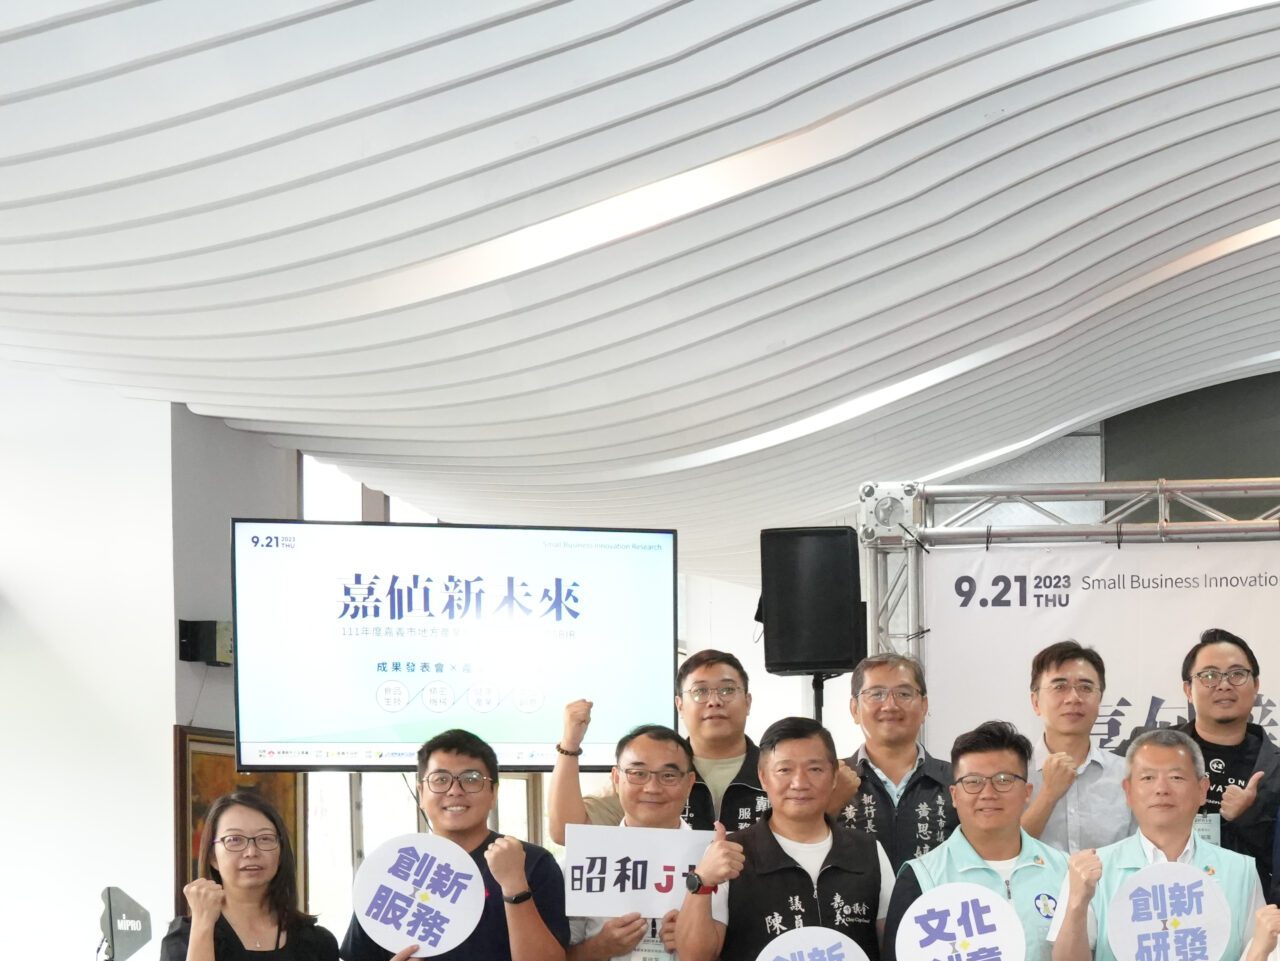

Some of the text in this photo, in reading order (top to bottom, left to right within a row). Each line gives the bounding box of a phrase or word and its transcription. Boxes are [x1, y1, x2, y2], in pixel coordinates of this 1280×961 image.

[251, 535, 279, 548] 9.21
[954, 575, 1028, 608] 9.21
[1033, 575, 1072, 589] 2023
[1081, 574, 1126, 590] Small
[1130, 573, 1200, 589] Business
[1033, 594, 1070, 608] THU
[387, 845, 473, 905] 創新
[364, 883, 450, 948] 服務
[1129, 879, 1205, 923] 創新
[914, 898, 997, 949] 文化
